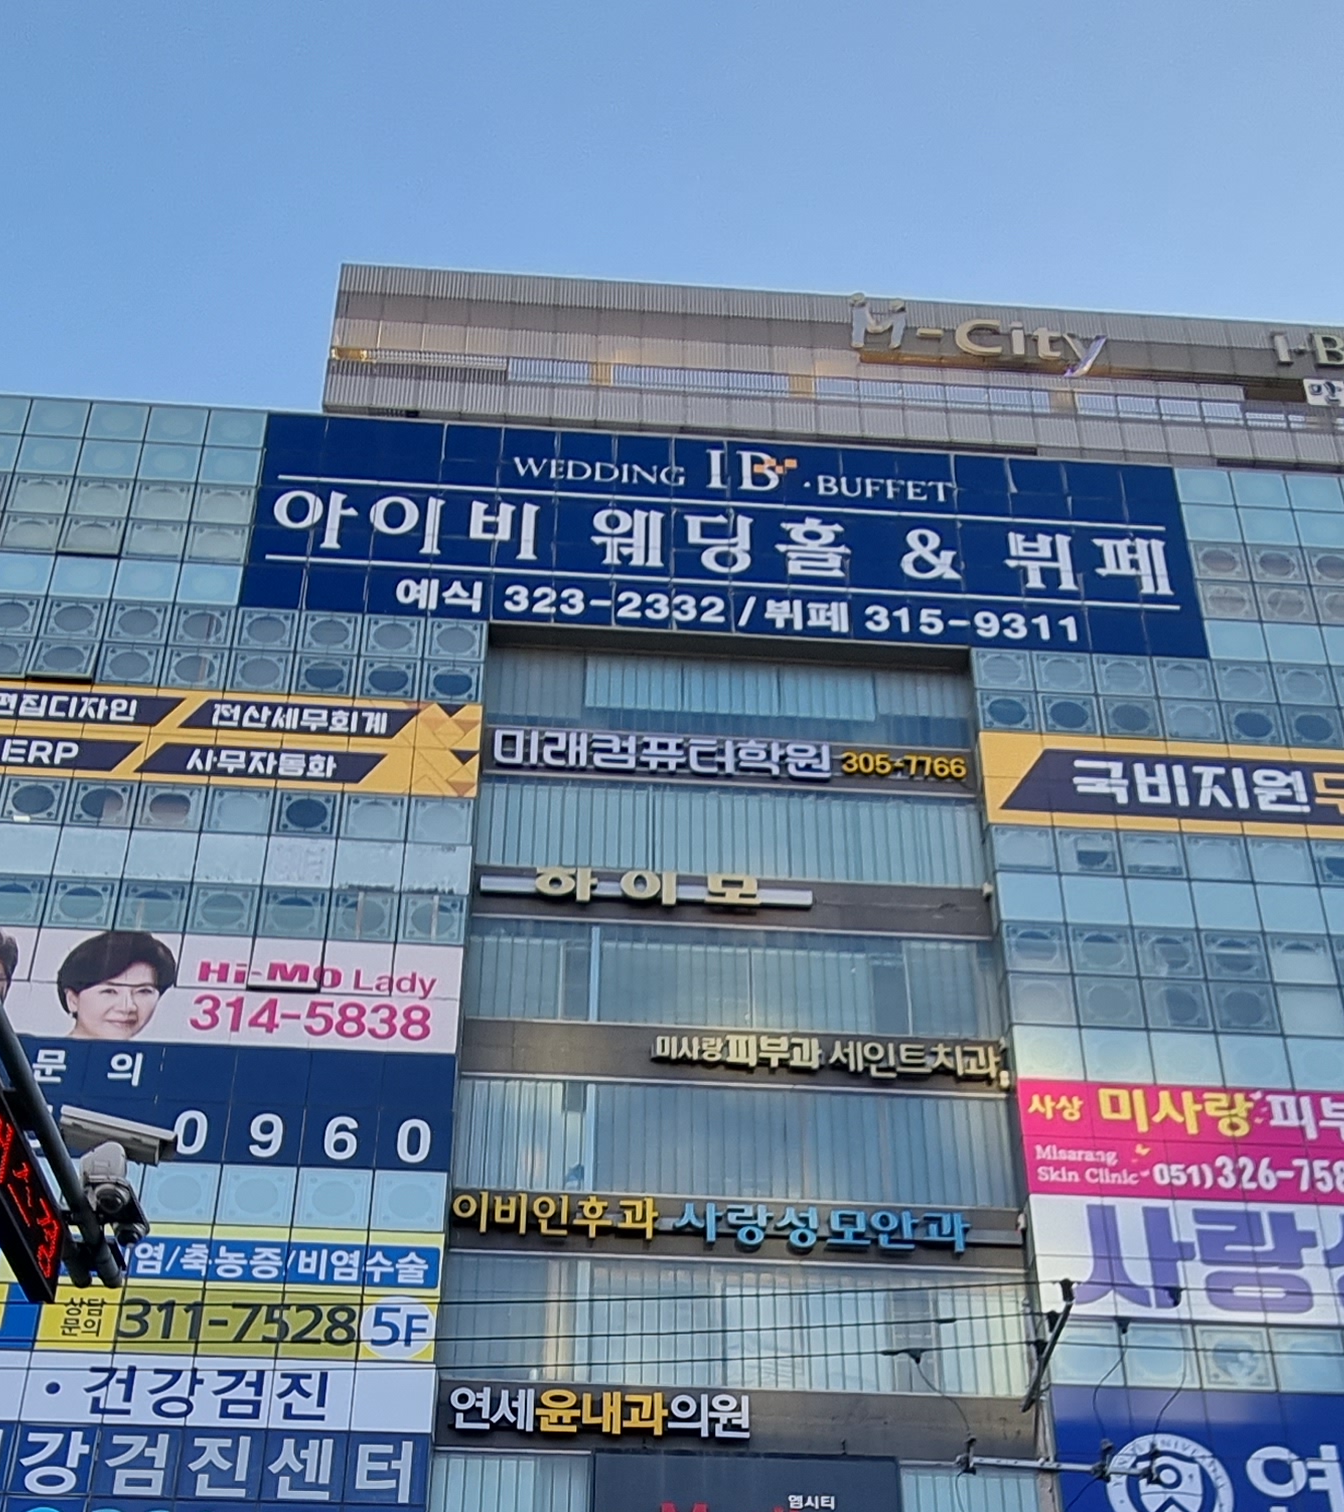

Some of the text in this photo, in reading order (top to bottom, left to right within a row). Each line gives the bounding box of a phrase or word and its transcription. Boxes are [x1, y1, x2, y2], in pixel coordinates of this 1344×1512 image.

[849, 292, 1108, 378] M-City
[513, 456, 685, 487] WEDDING
[272, 488, 1175, 596] 아이비 웨딩홀 & 뷔페
[395, 576, 1079, 643] 예식 315-9311
[212, 700, 390, 736] 전산세무회계
[0, 739, 80, 767] ERP
[185, 746, 339, 782] 사무자동화
[493, 728, 968, 780] 미래컴퓨터학원 305-7766
[534, 866, 761, 906] 하이모
[197, 960, 437, 998] Hi-MO Lady
[188, 994, 432, 1042] 314-5838
[828, 1040, 1001, 1080] 세인트치과
[1027, 1093, 1083, 1122] 사상
[453, 1190, 971, 1253] 이비인후과 사랑성모안과
[116, 1296, 357, 1346] 311-7528
[369, 1305, 431, 1348] 5F
[83, 1363, 329, 1422] 건강검진
[449, 1385, 751, 1440] 연세윤내과의원
